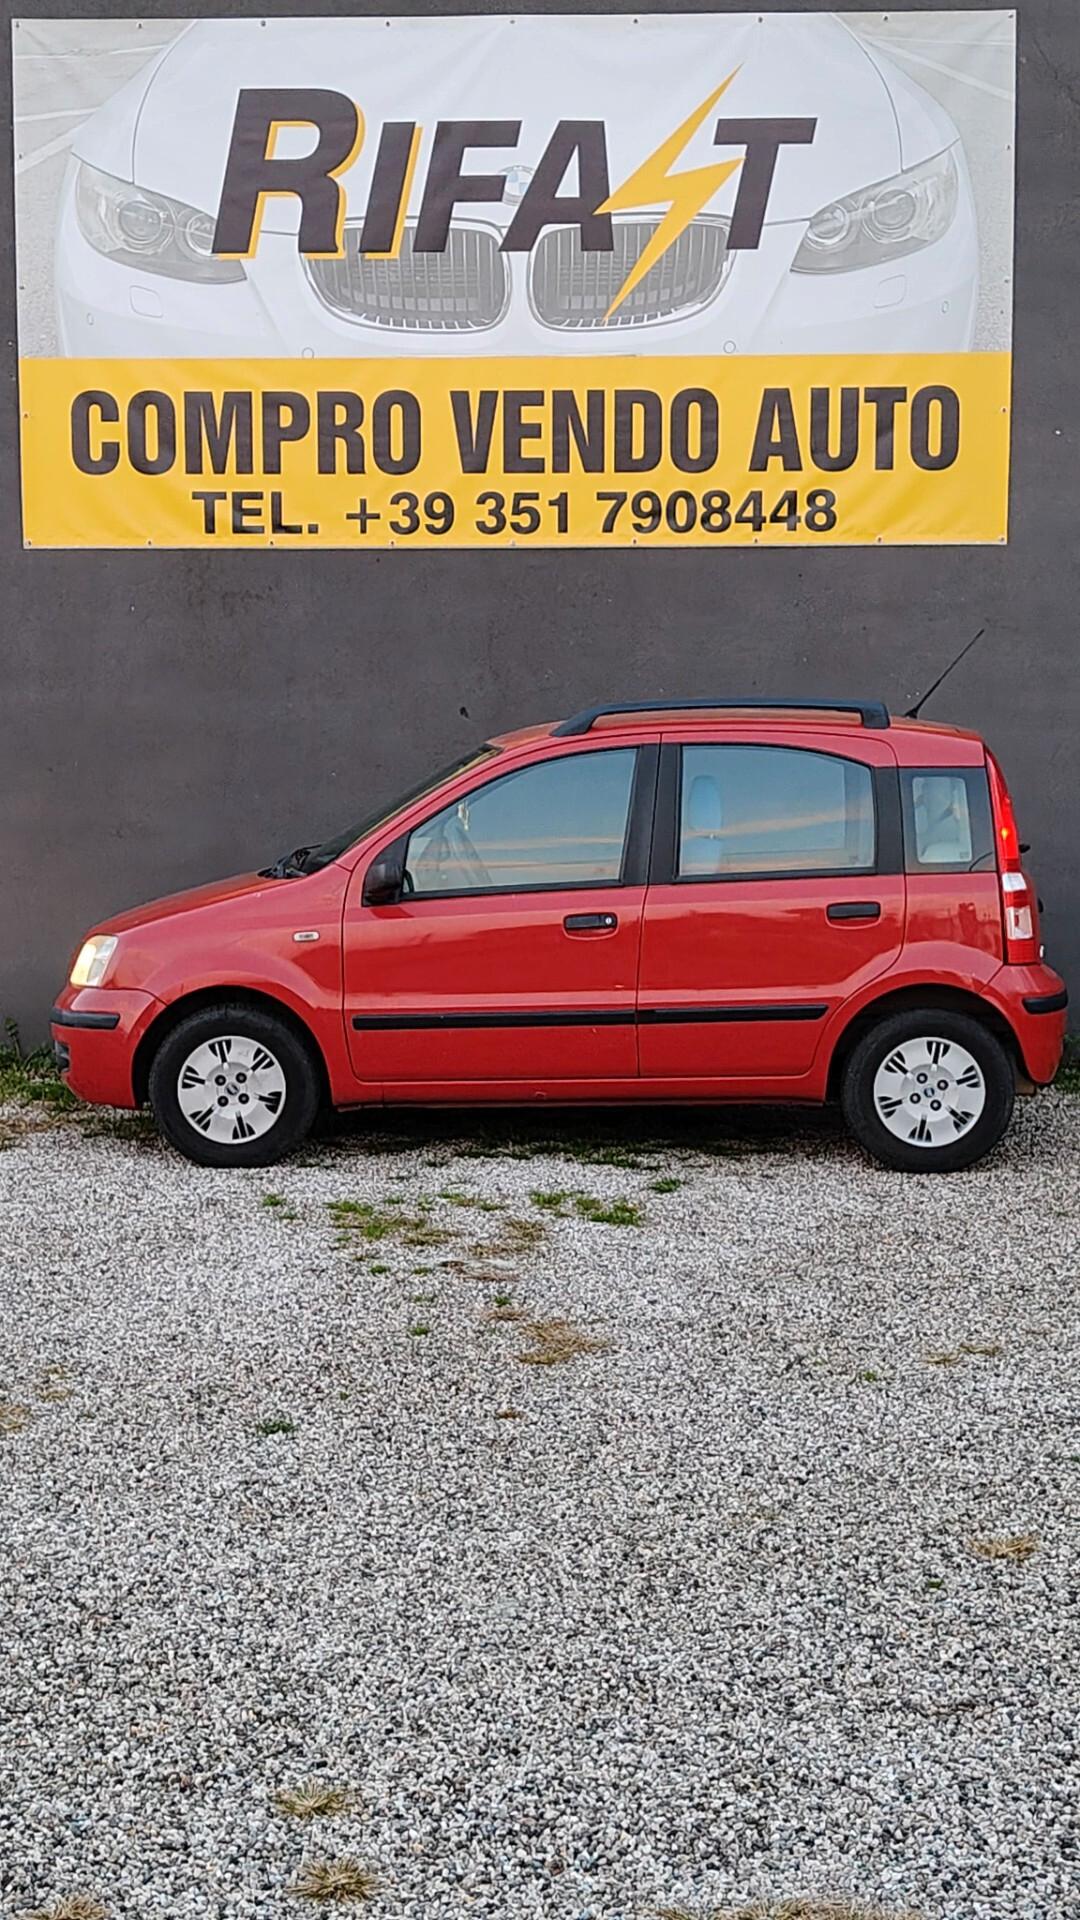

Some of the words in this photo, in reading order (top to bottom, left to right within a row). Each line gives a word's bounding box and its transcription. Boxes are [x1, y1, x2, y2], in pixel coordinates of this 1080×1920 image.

[70, 389, 422, 476] COMPRO
[449, 387, 719, 474] VENDO
[748, 385, 960, 473] AUTO
[191, 491, 319, 535] TEL.
[346, 491, 455, 535] +39
[475, 491, 569, 535] 351
[596, 488, 837, 534] 7908448
